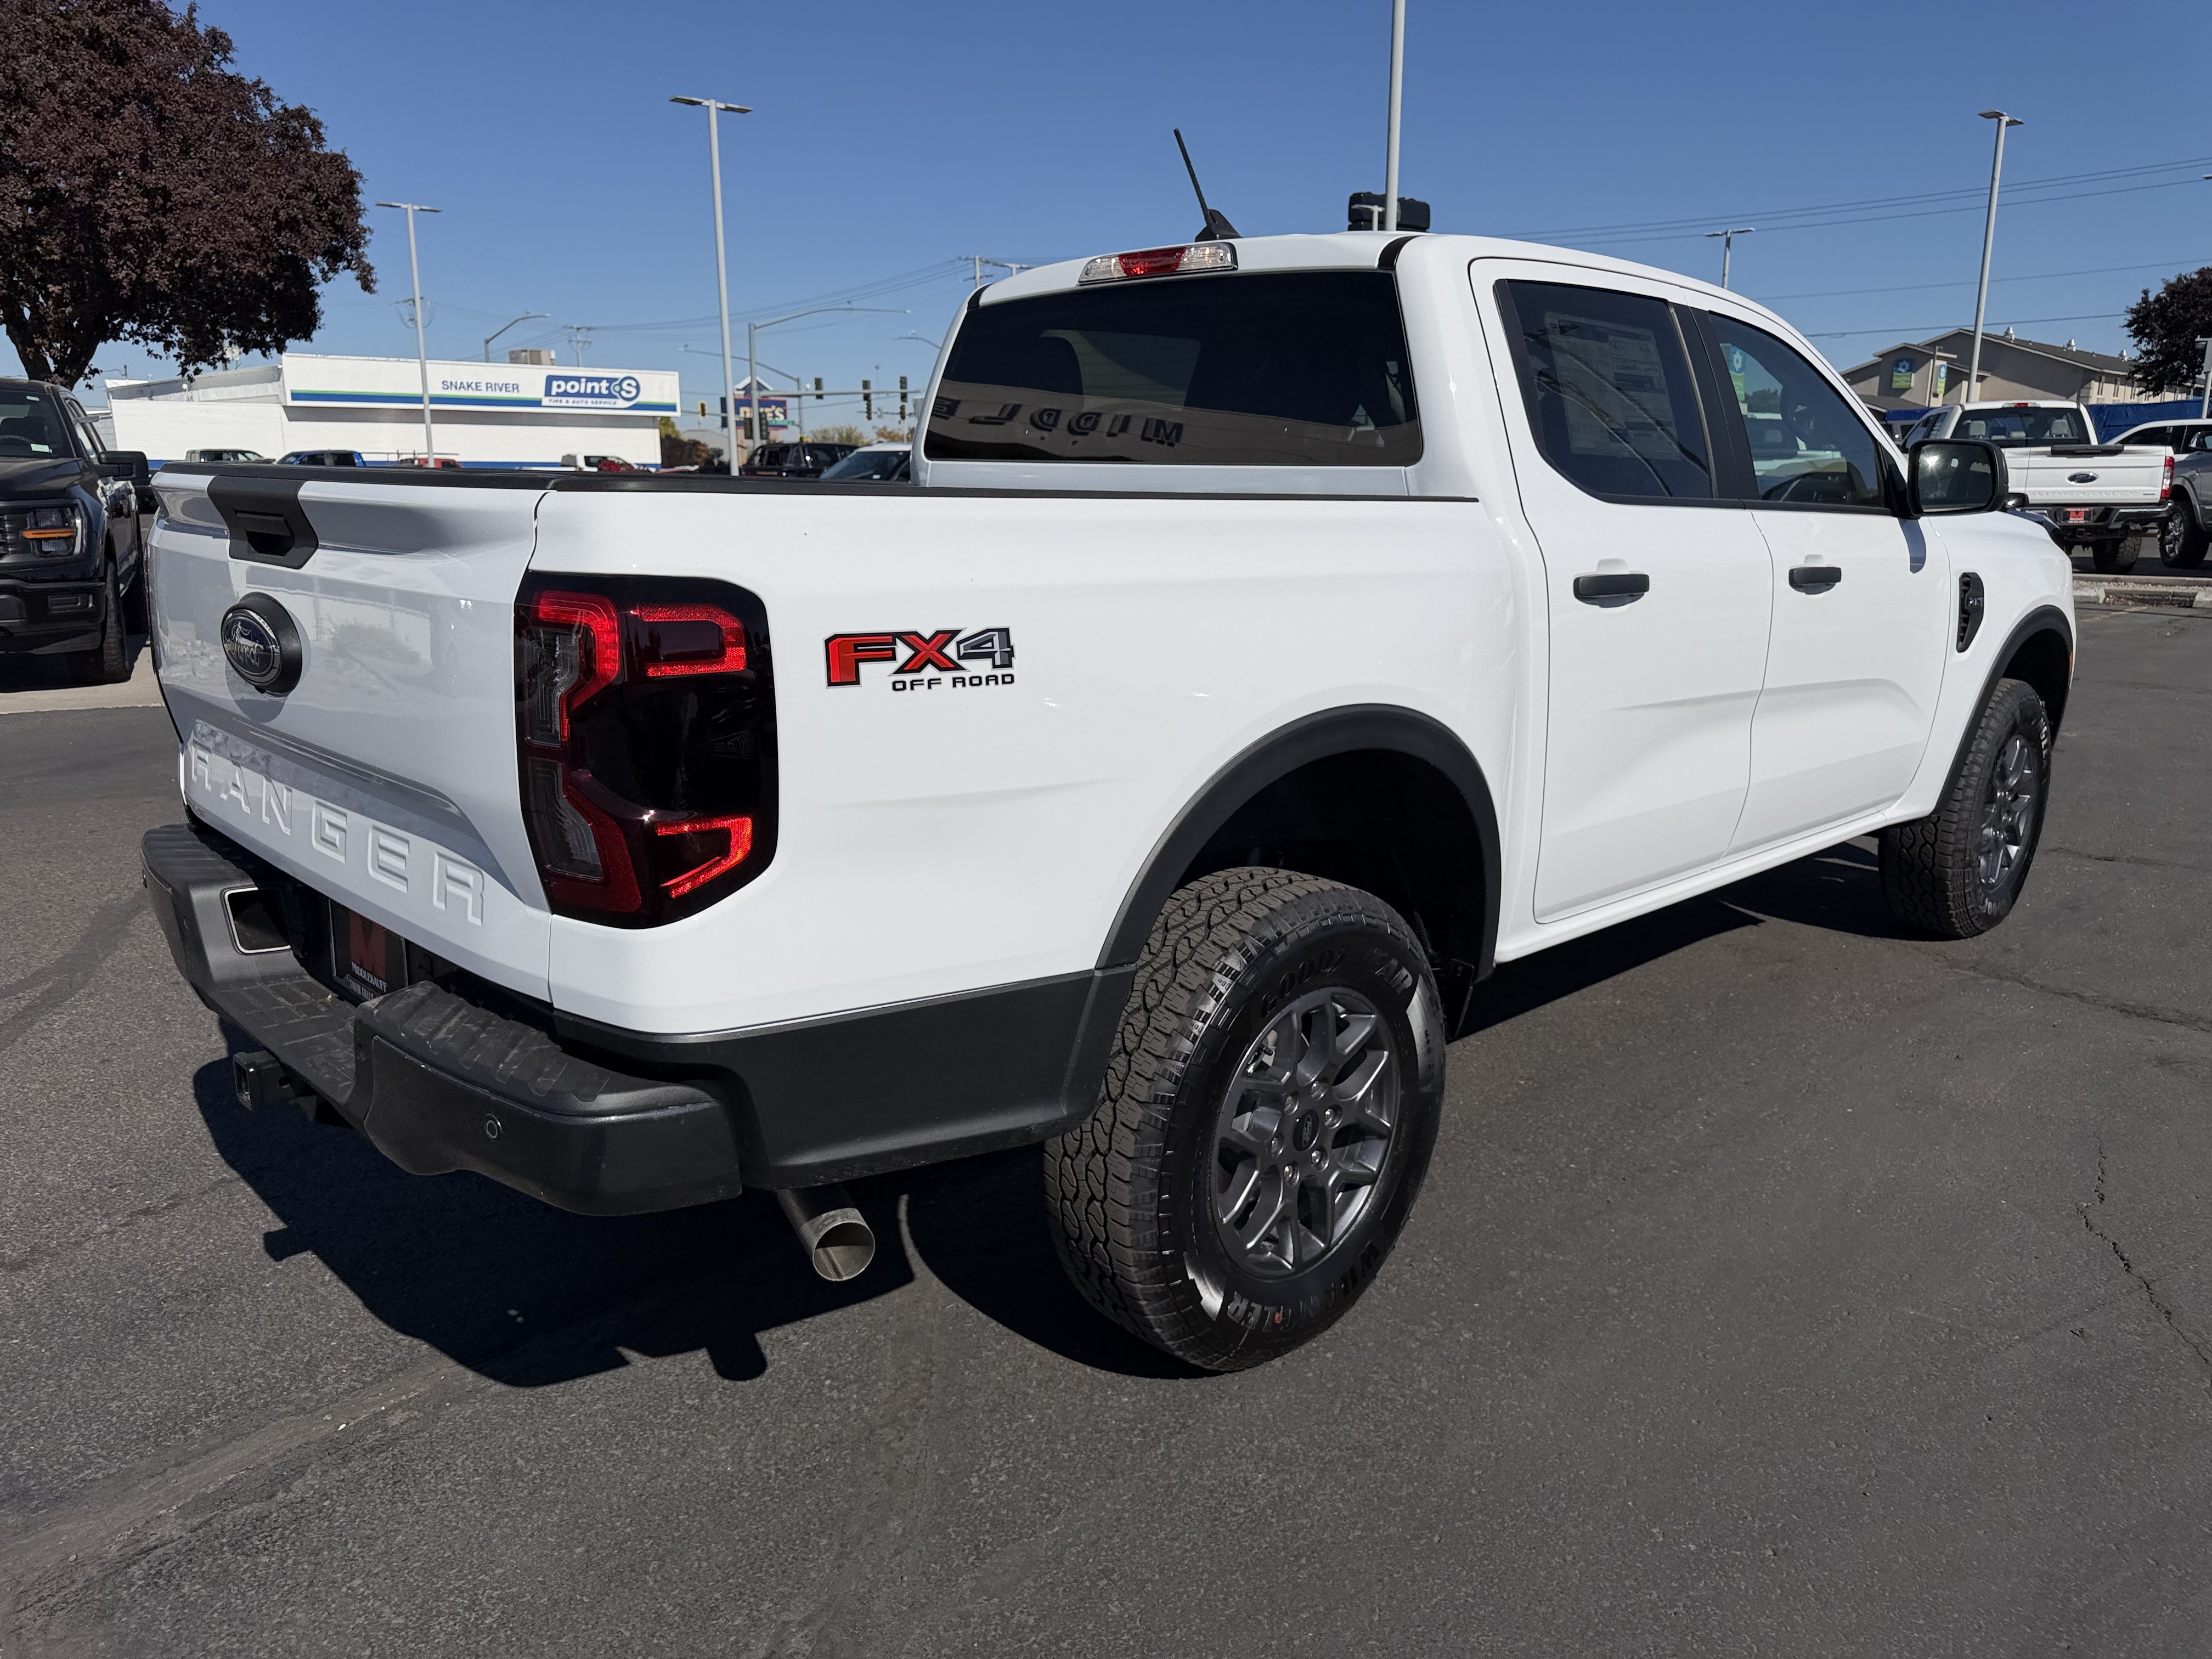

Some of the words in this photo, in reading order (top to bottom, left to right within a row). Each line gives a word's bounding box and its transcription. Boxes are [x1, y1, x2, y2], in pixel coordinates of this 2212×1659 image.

[441, 380, 482, 392] SNAKE
[486, 381, 520, 393] RIVER
[550, 378, 610, 396] point
[619, 379, 637, 398] S
[228, 621, 260, 667] Ford
[823, 626, 1015, 688] FX4
[892, 678, 942, 692] OFF
[952, 674, 1015, 689] ROAD
[190, 738, 485, 926] RANGER
